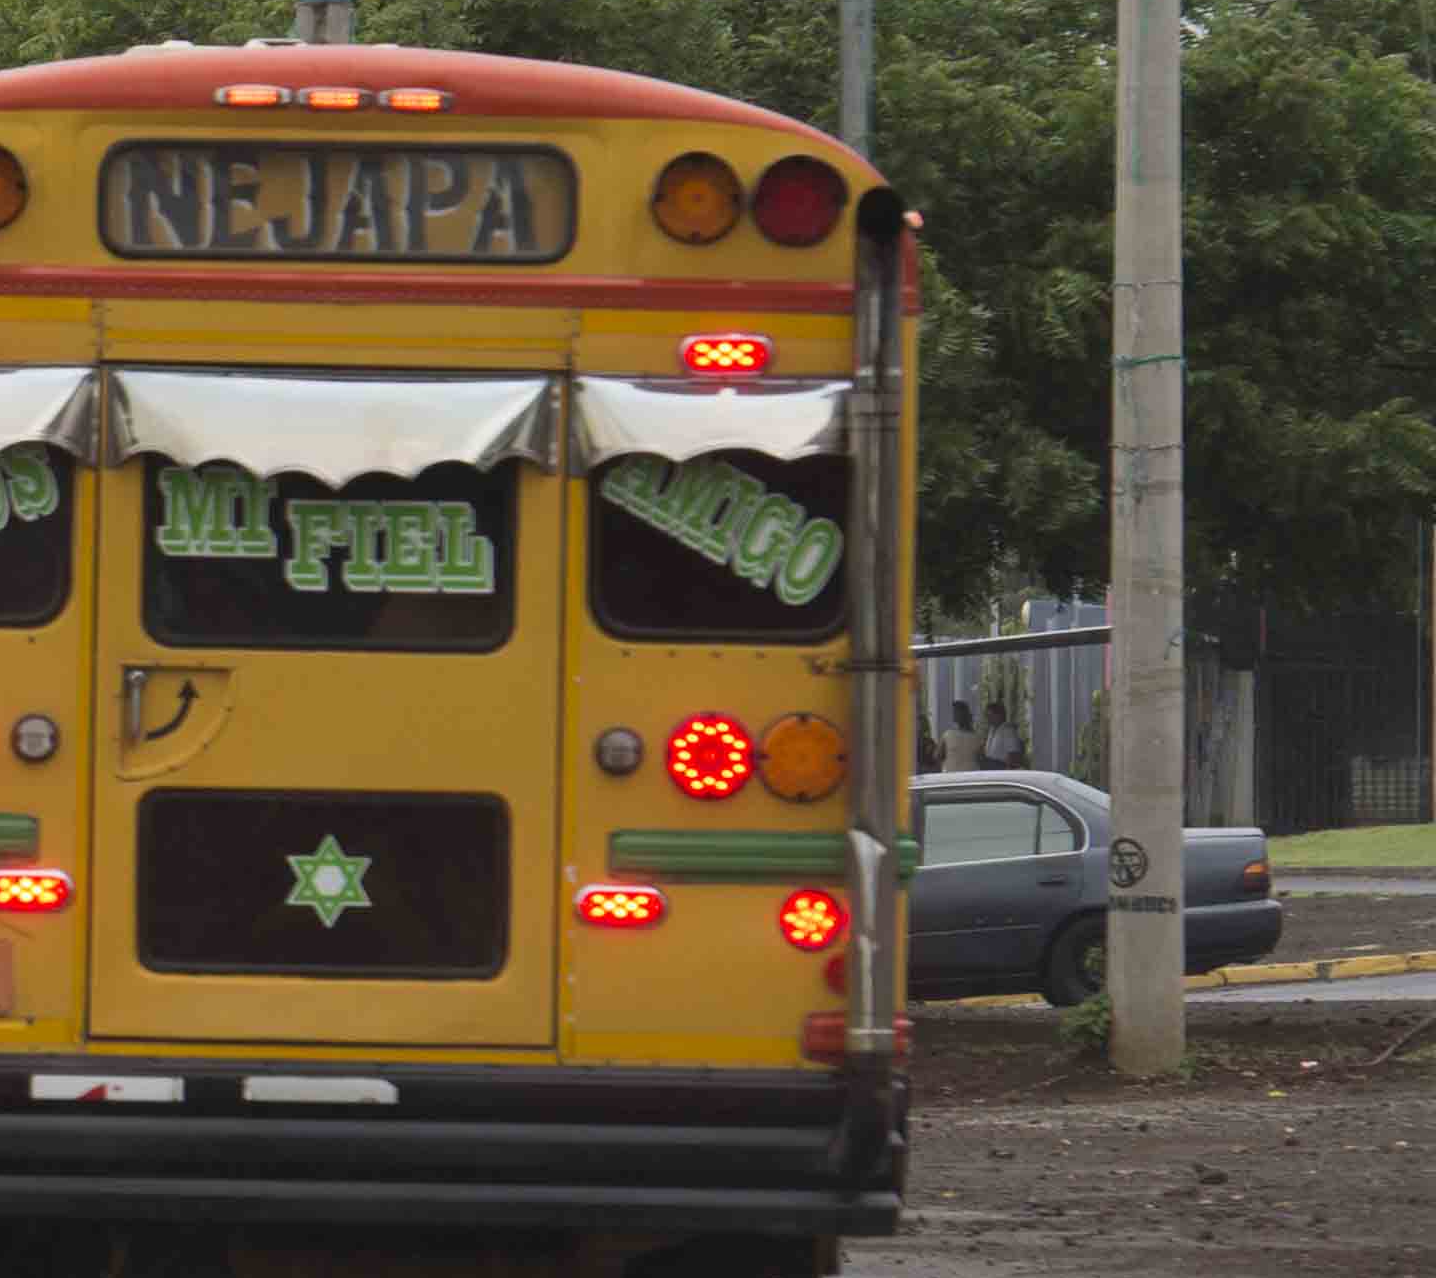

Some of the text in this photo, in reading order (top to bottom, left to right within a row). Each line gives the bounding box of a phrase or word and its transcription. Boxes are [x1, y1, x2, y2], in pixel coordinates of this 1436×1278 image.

[125, 149, 539, 251] NEJAPA
[157, 468, 494, 594] MI FIEL
[602, 460, 844, 606] AMIGO
